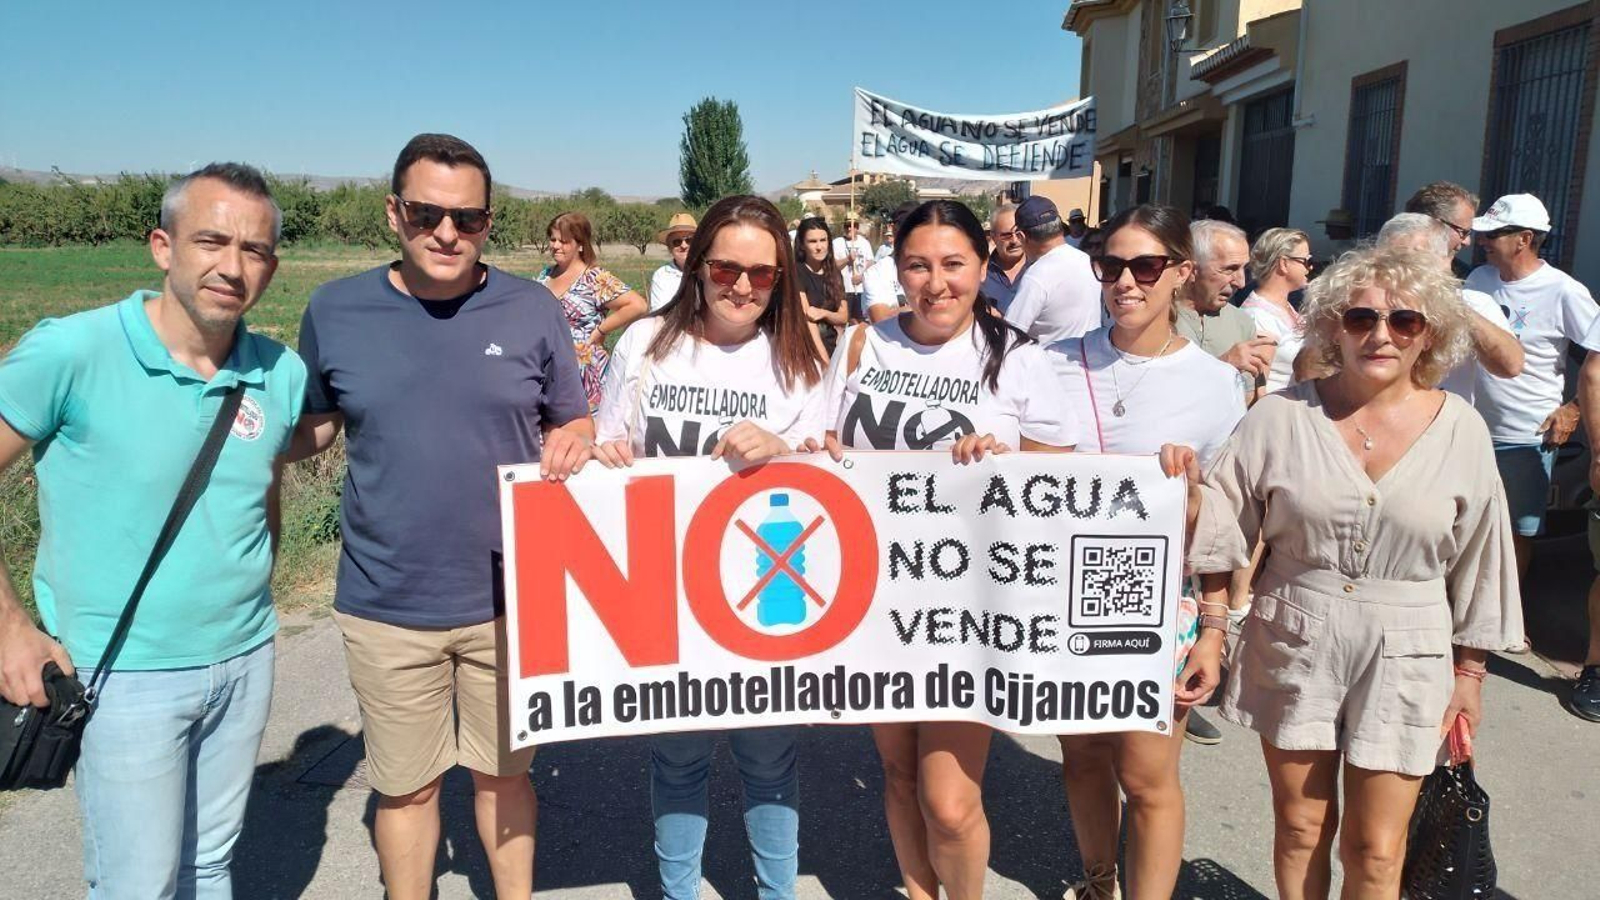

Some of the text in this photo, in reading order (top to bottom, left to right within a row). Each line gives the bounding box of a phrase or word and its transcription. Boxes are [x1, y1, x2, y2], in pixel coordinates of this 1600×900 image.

[870, 99, 1097, 140] EL AGUA NO SE VENDE
[861, 131, 1090, 172] EL AGUA SE DEFIENDE
[650, 383, 768, 420] EMBOTELLADORA
[860, 366, 980, 405] EMBOTELLADORA
[887, 472, 1149, 520] EL AGUA
[512, 462, 879, 679] NO
[888, 537, 1058, 586] NO SE
[888, 606, 1060, 653] VENDE
[1093, 637, 1150, 649] FIRMA AQUÍ
[528, 663, 1160, 732] a la embotelladora de Cijancos
